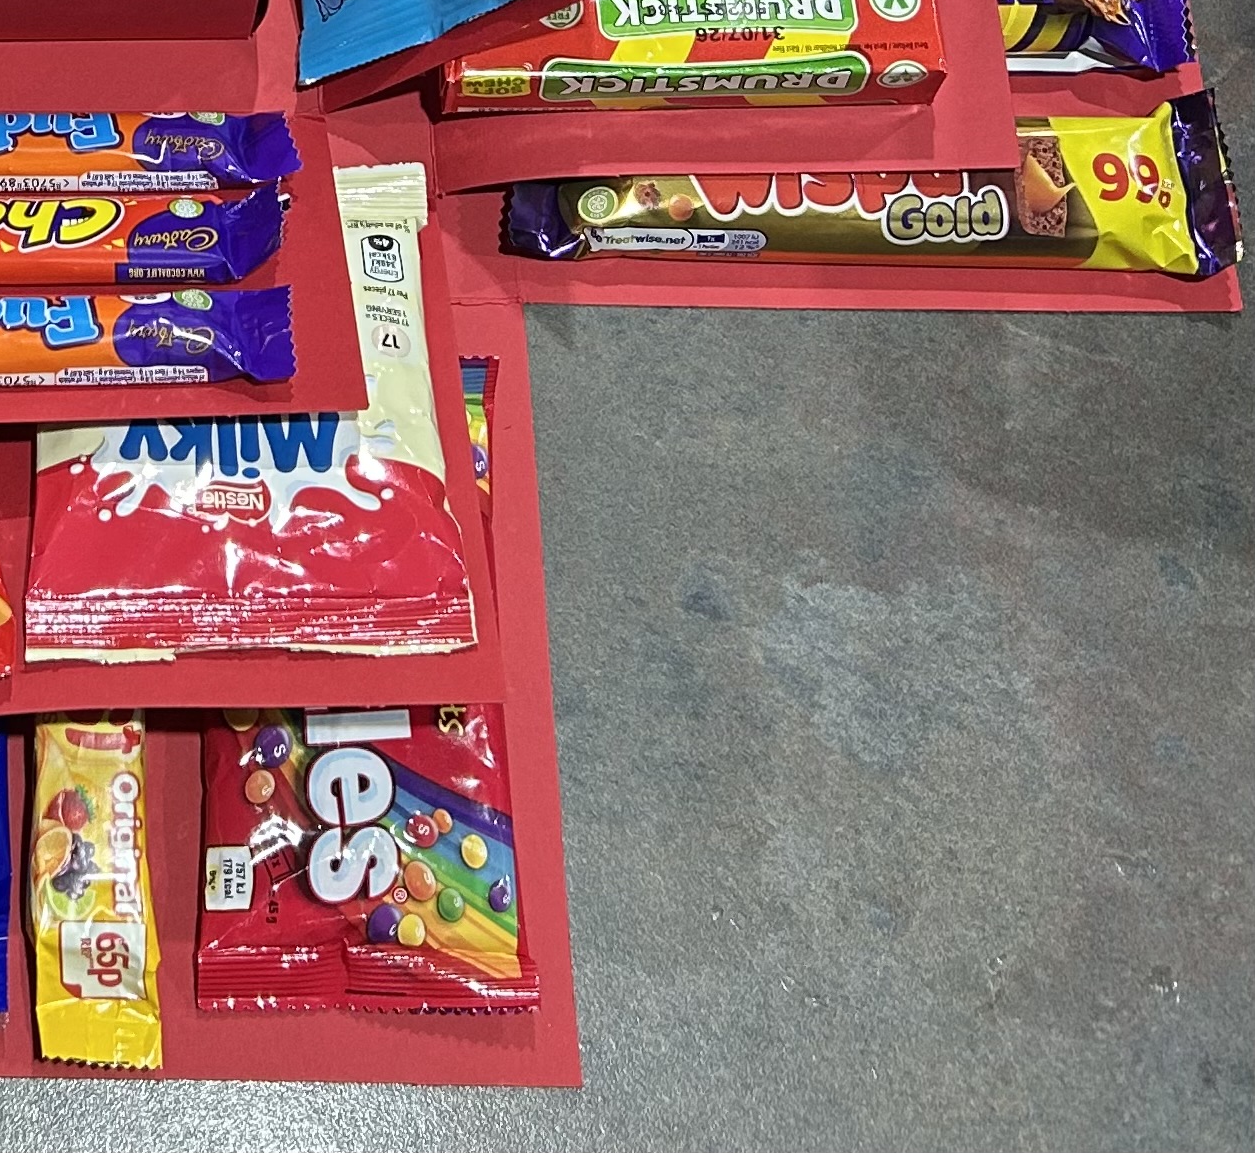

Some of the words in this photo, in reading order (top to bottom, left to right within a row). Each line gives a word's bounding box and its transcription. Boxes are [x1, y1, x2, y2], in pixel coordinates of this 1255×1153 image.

[463, 76, 527, 89] CHEW
[468, 85, 526, 96] SOFT
[556, 69, 854, 96] DRUMSTICK
[143, 129, 224, 161] Cadbury
[1091, 151, 1173, 210] 99p
[883, 185, 1008, 242] Gold
[133, 227, 218, 253] Cadbury
[369, 266, 399, 279] Energy
[381, 333, 401, 350] 17
[223, 858, 234, 875] 179
[235, 862, 246, 879] 757
[223, 878, 235, 899] kcal
[235, 882, 246, 894] kJ
[87, 931, 130, 989] 65p
